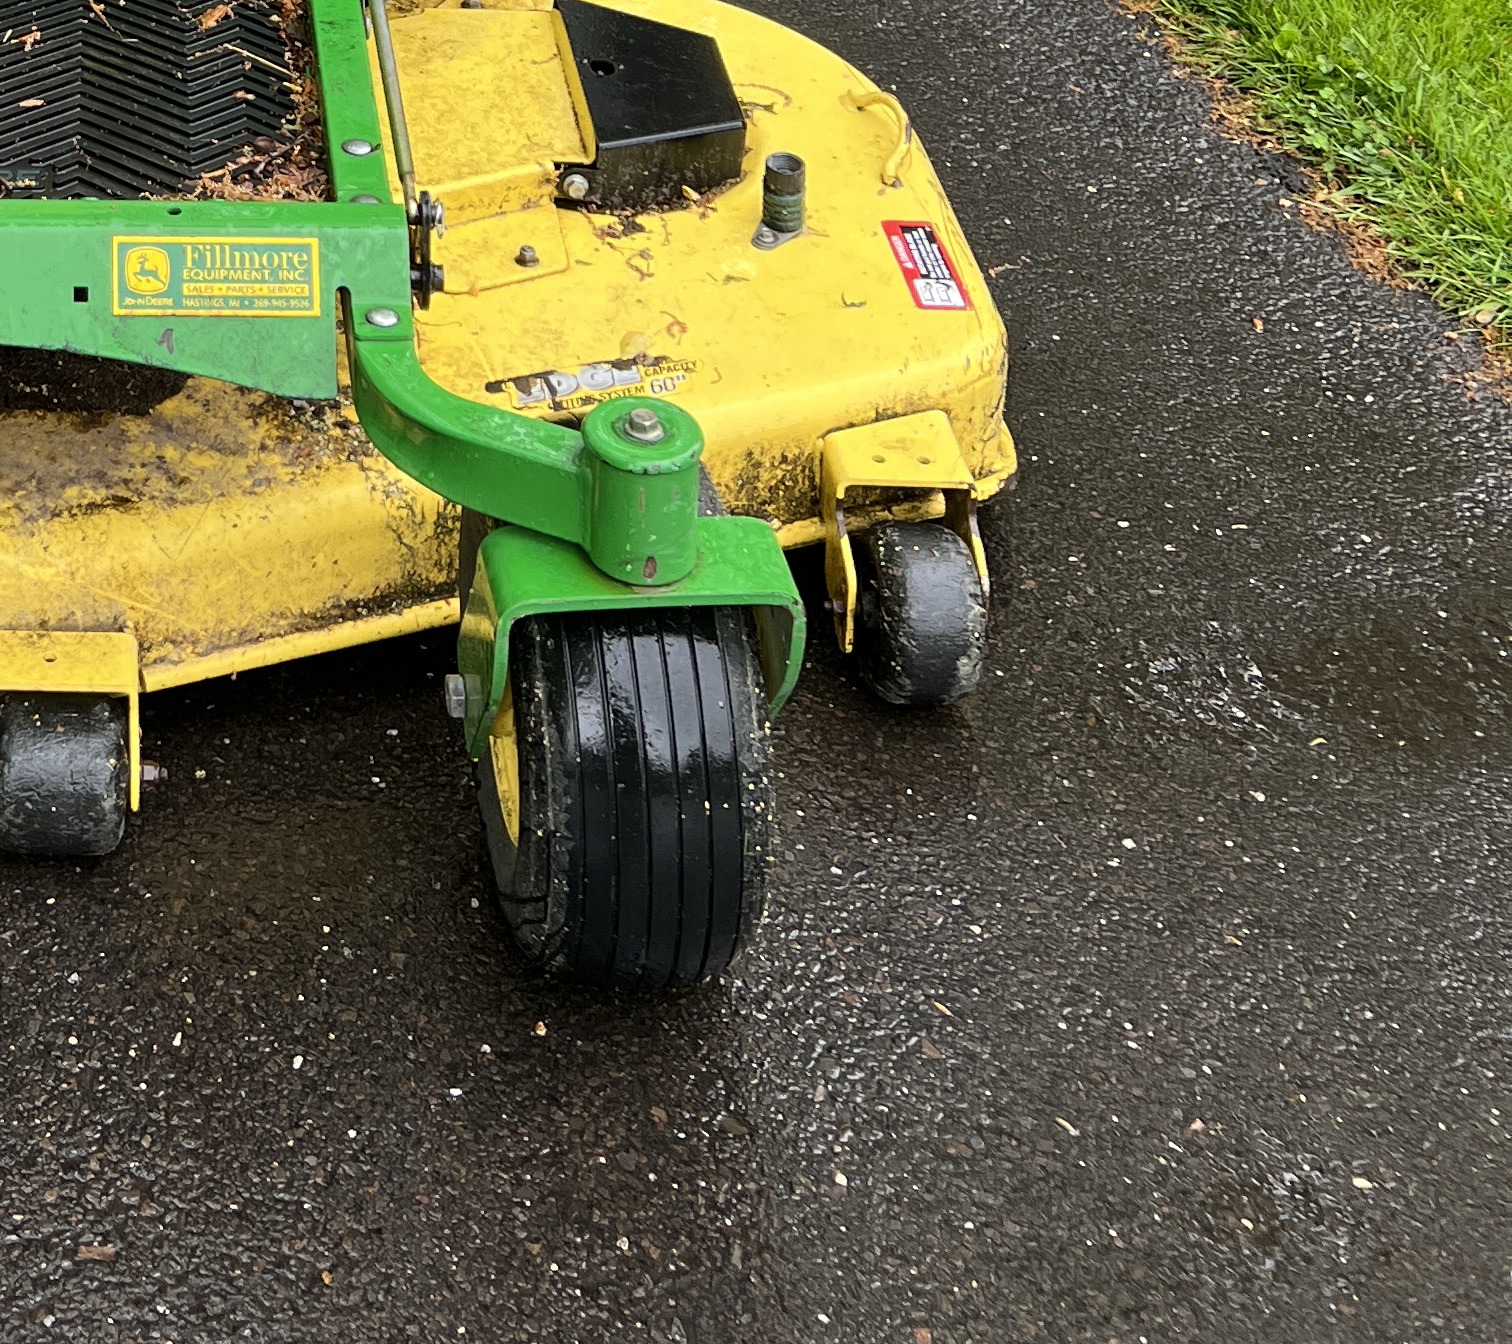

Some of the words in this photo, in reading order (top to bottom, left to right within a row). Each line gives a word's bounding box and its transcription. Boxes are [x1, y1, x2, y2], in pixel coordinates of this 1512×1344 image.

[183, 245, 308, 269] Fillmore
[186, 286, 214, 294] SALES
[226, 286, 256, 294] PARTS
[267, 286, 306, 295] SERVICE
[644, 359, 698, 377] CAPACITY
[599, 385, 646, 401] SYSTEM
